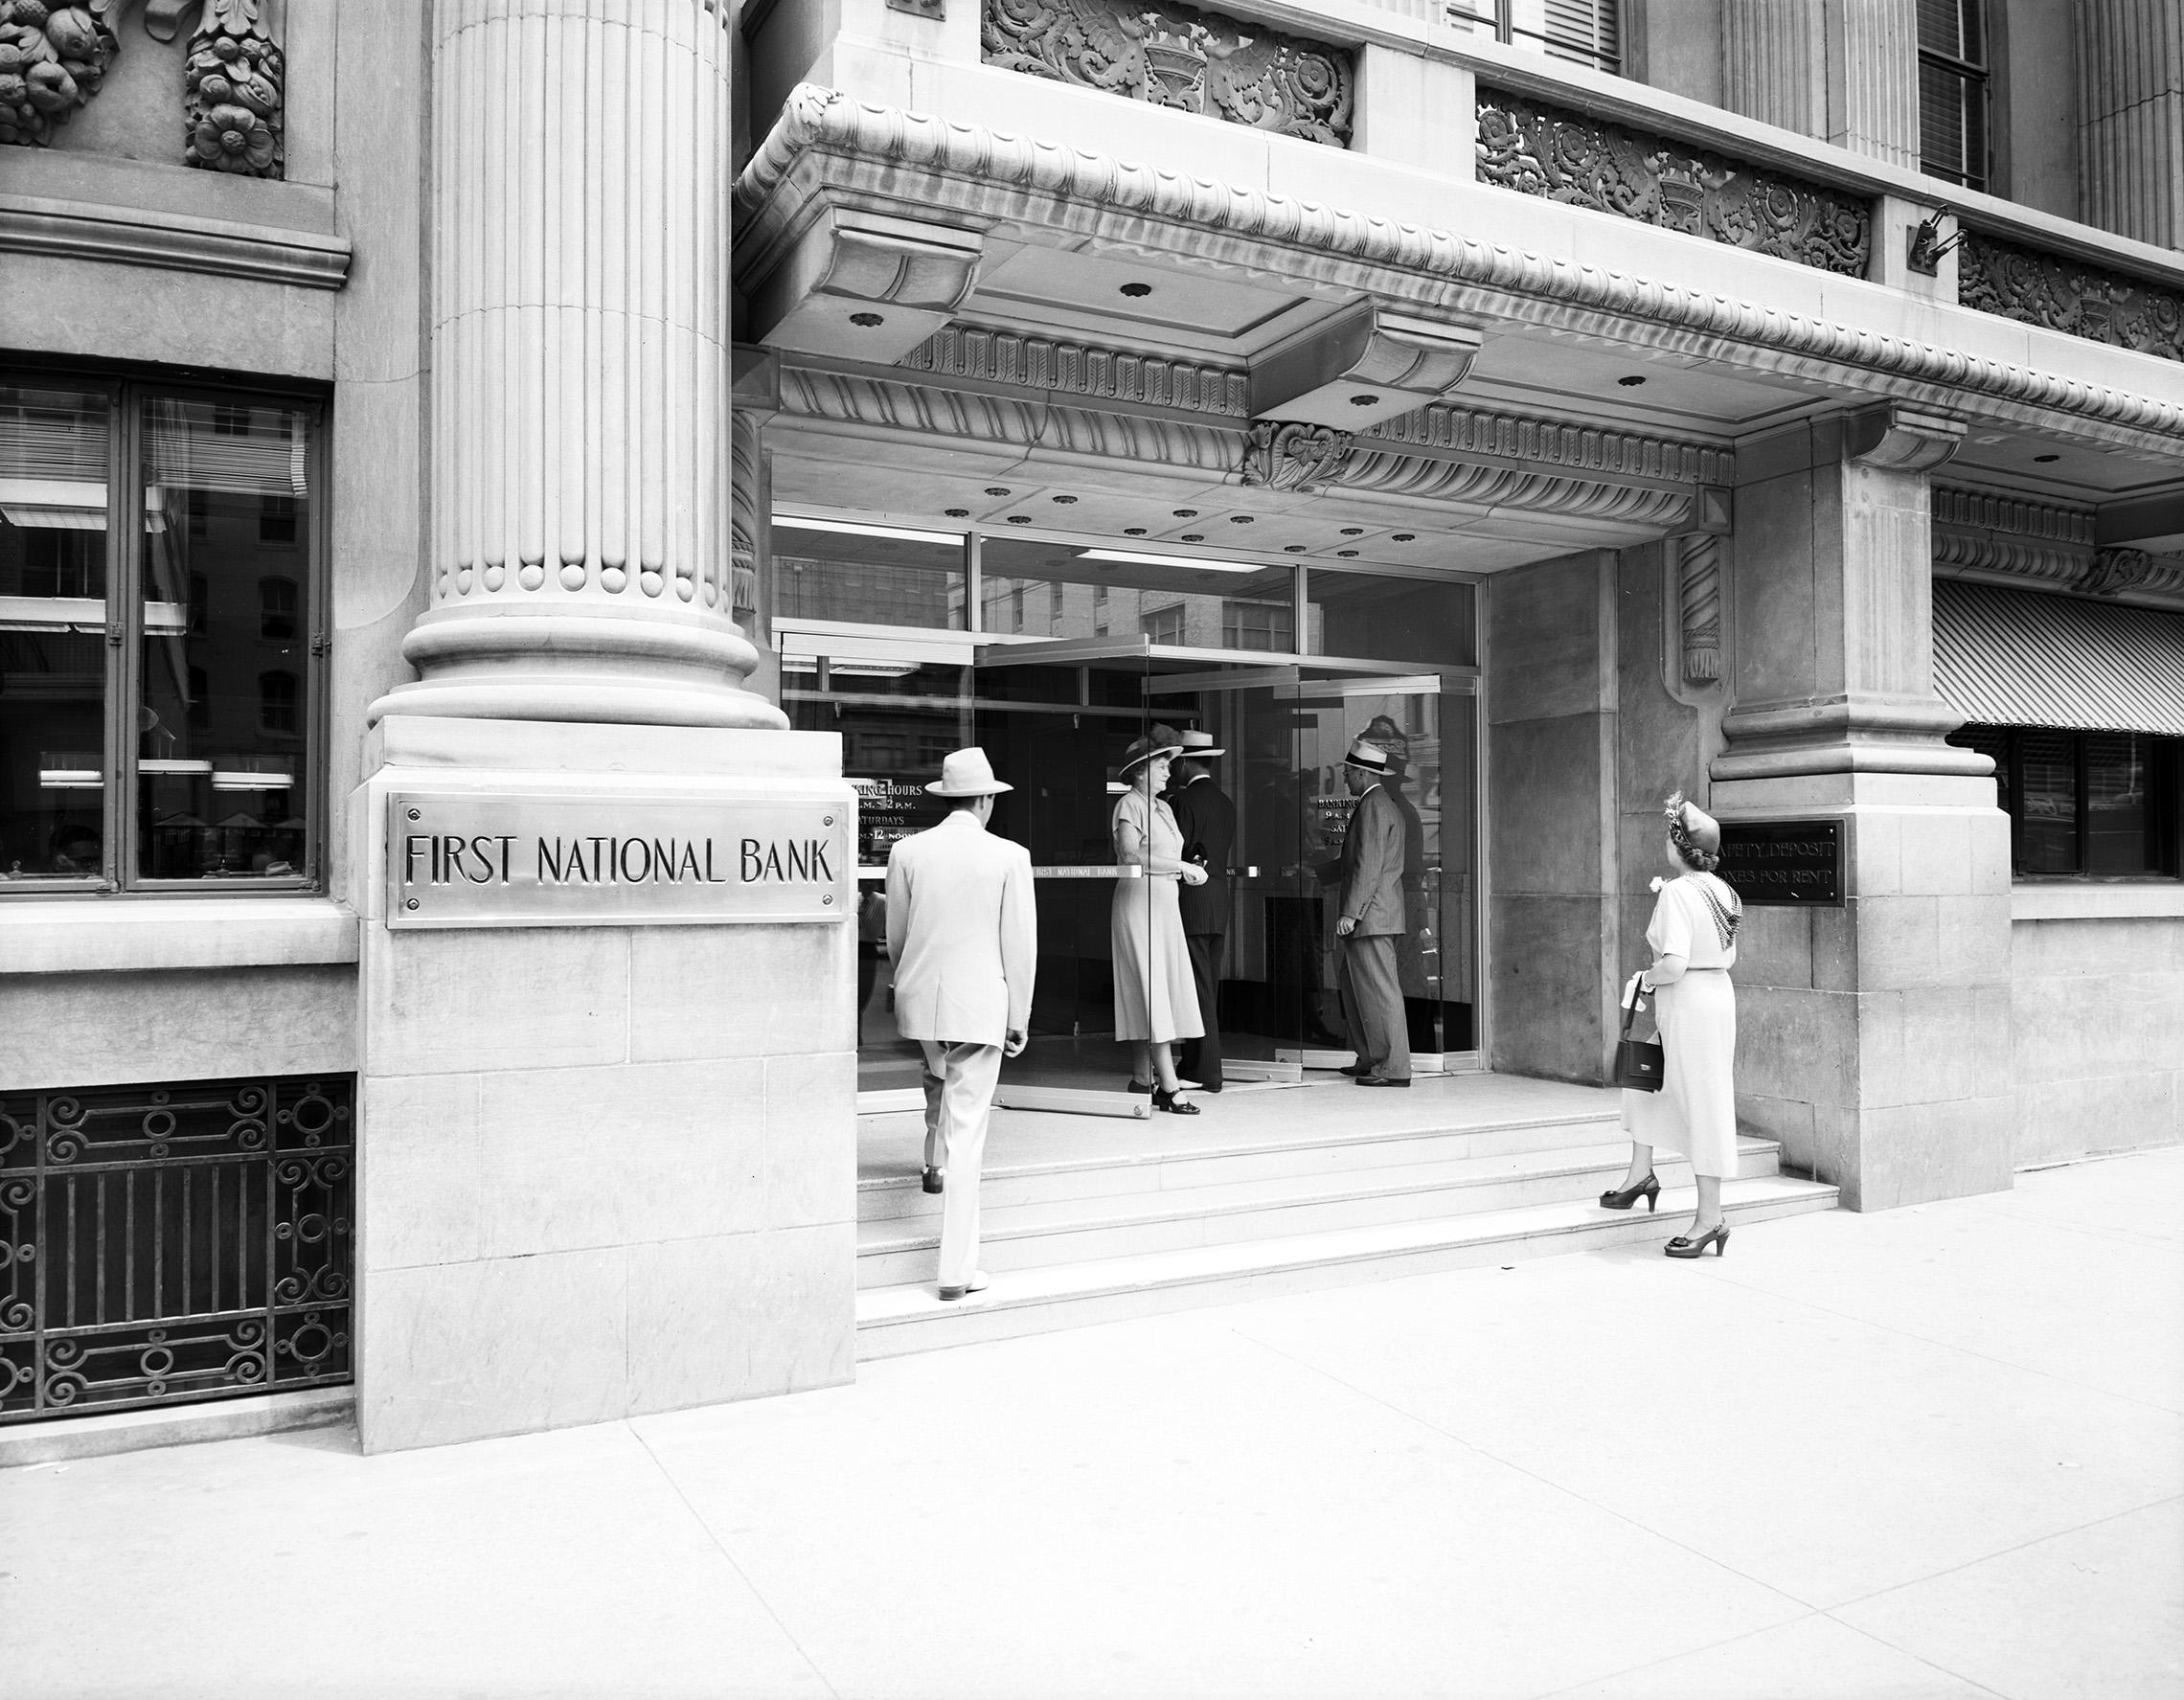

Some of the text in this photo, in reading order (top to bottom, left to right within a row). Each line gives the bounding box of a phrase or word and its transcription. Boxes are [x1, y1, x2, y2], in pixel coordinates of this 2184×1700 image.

[887, 784, 922, 796] HOURS
[886, 799, 894, 809] 2
[895, 802, 917, 810] P.M.
[1317, 799, 1359, 809] BANKING
[858, 815, 905, 826] ATURDAYS
[1325, 810, 1351, 821] 9 A.M
[873, 828, 884, 840] 12
[1718, 841, 1836, 858] AFETY DEPOSIT
[404, 835, 835, 886] FIRST NATIONAL BANK
[1035, 867, 1118, 876] IRST NATIONAL BANK
[1759, 869, 1788, 884] FOR
[1791, 869, 1833, 884] RENT
